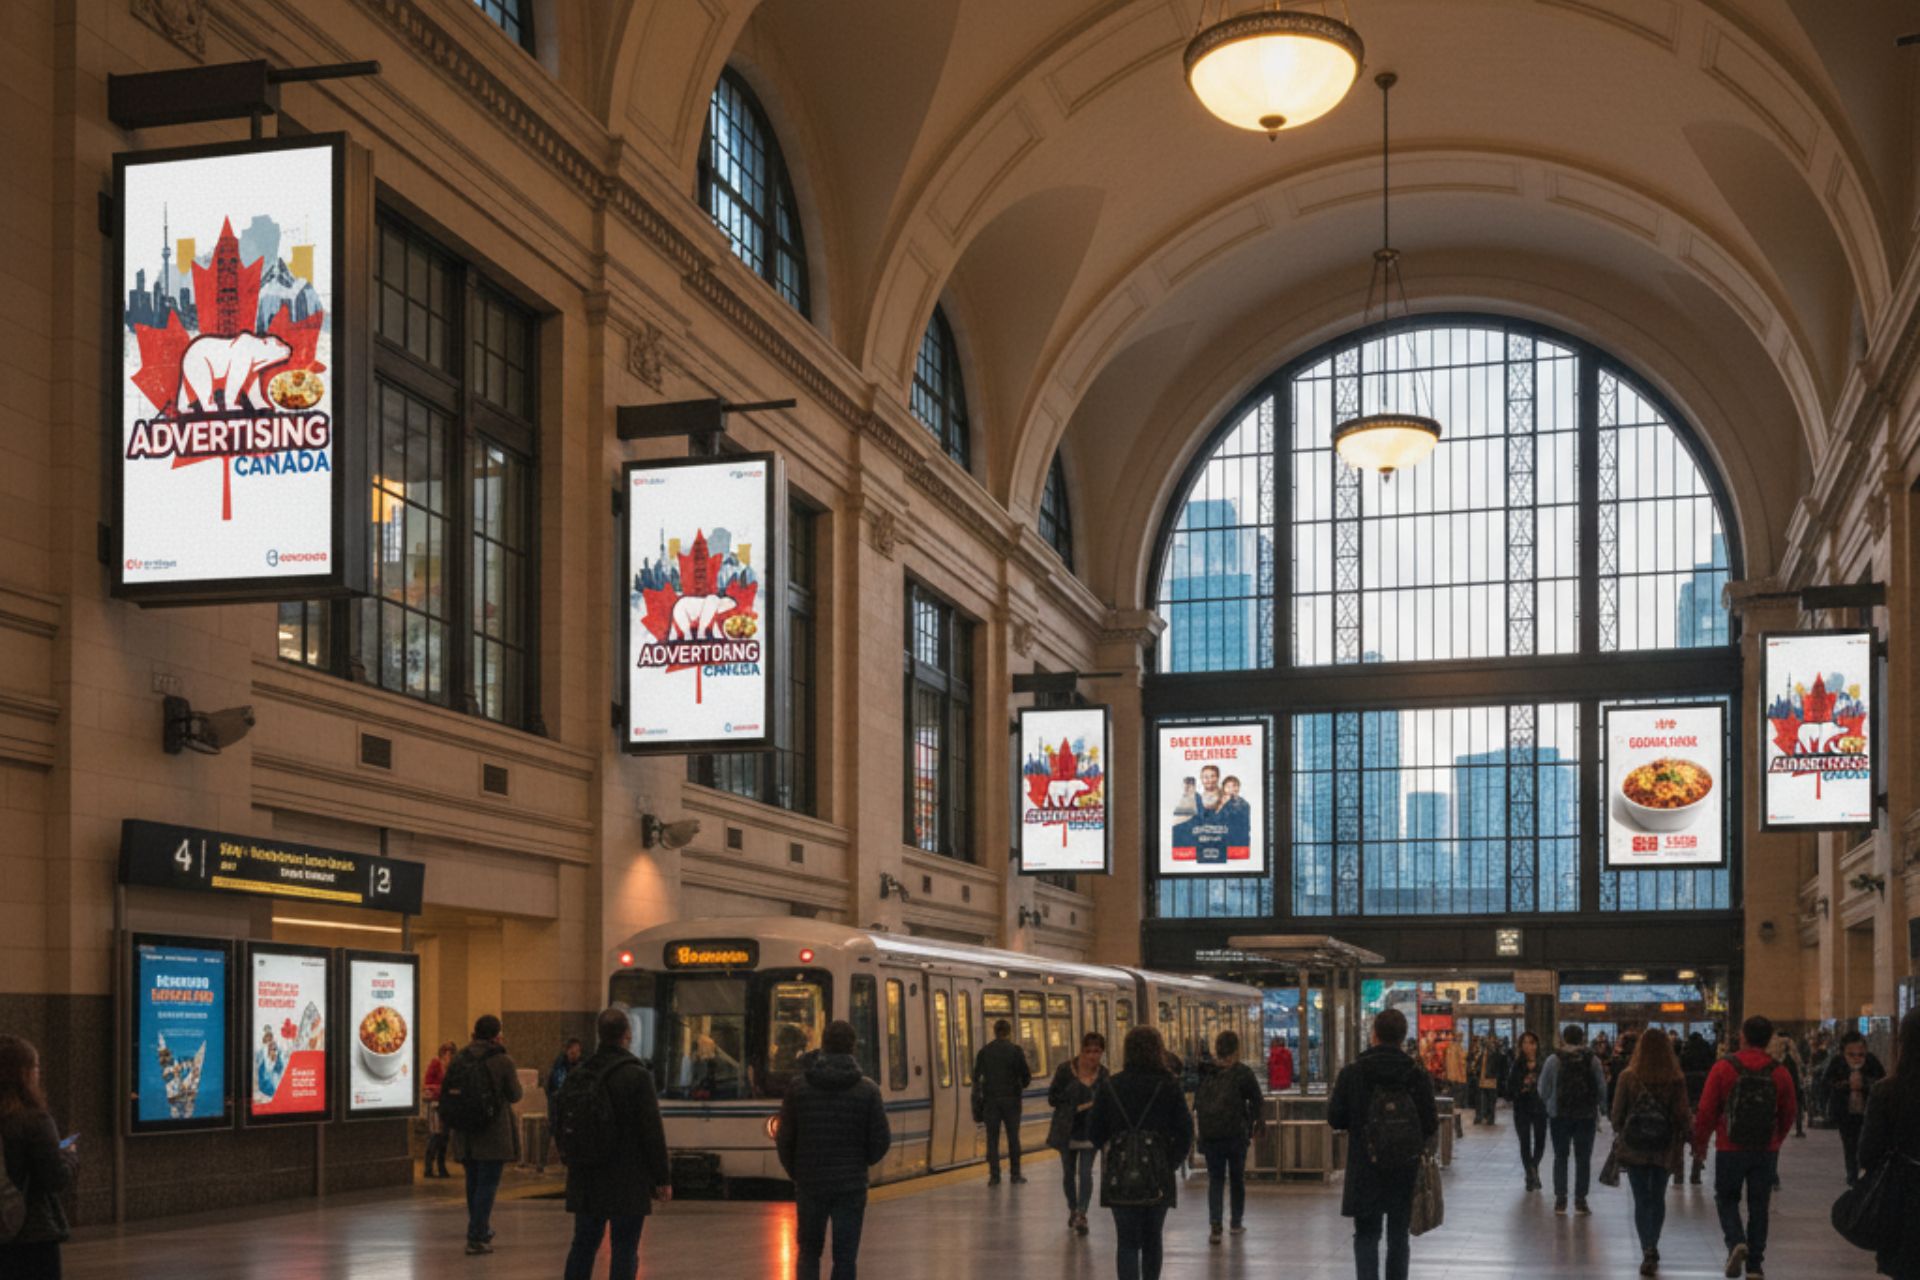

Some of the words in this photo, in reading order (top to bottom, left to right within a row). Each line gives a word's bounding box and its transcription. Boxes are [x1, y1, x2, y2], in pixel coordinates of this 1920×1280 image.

[128, 414, 328, 457] ADVERTISING
[234, 450, 331, 477] CANADA
[174, 839, 192, 872] 4
[377, 867, 391, 893] 2
